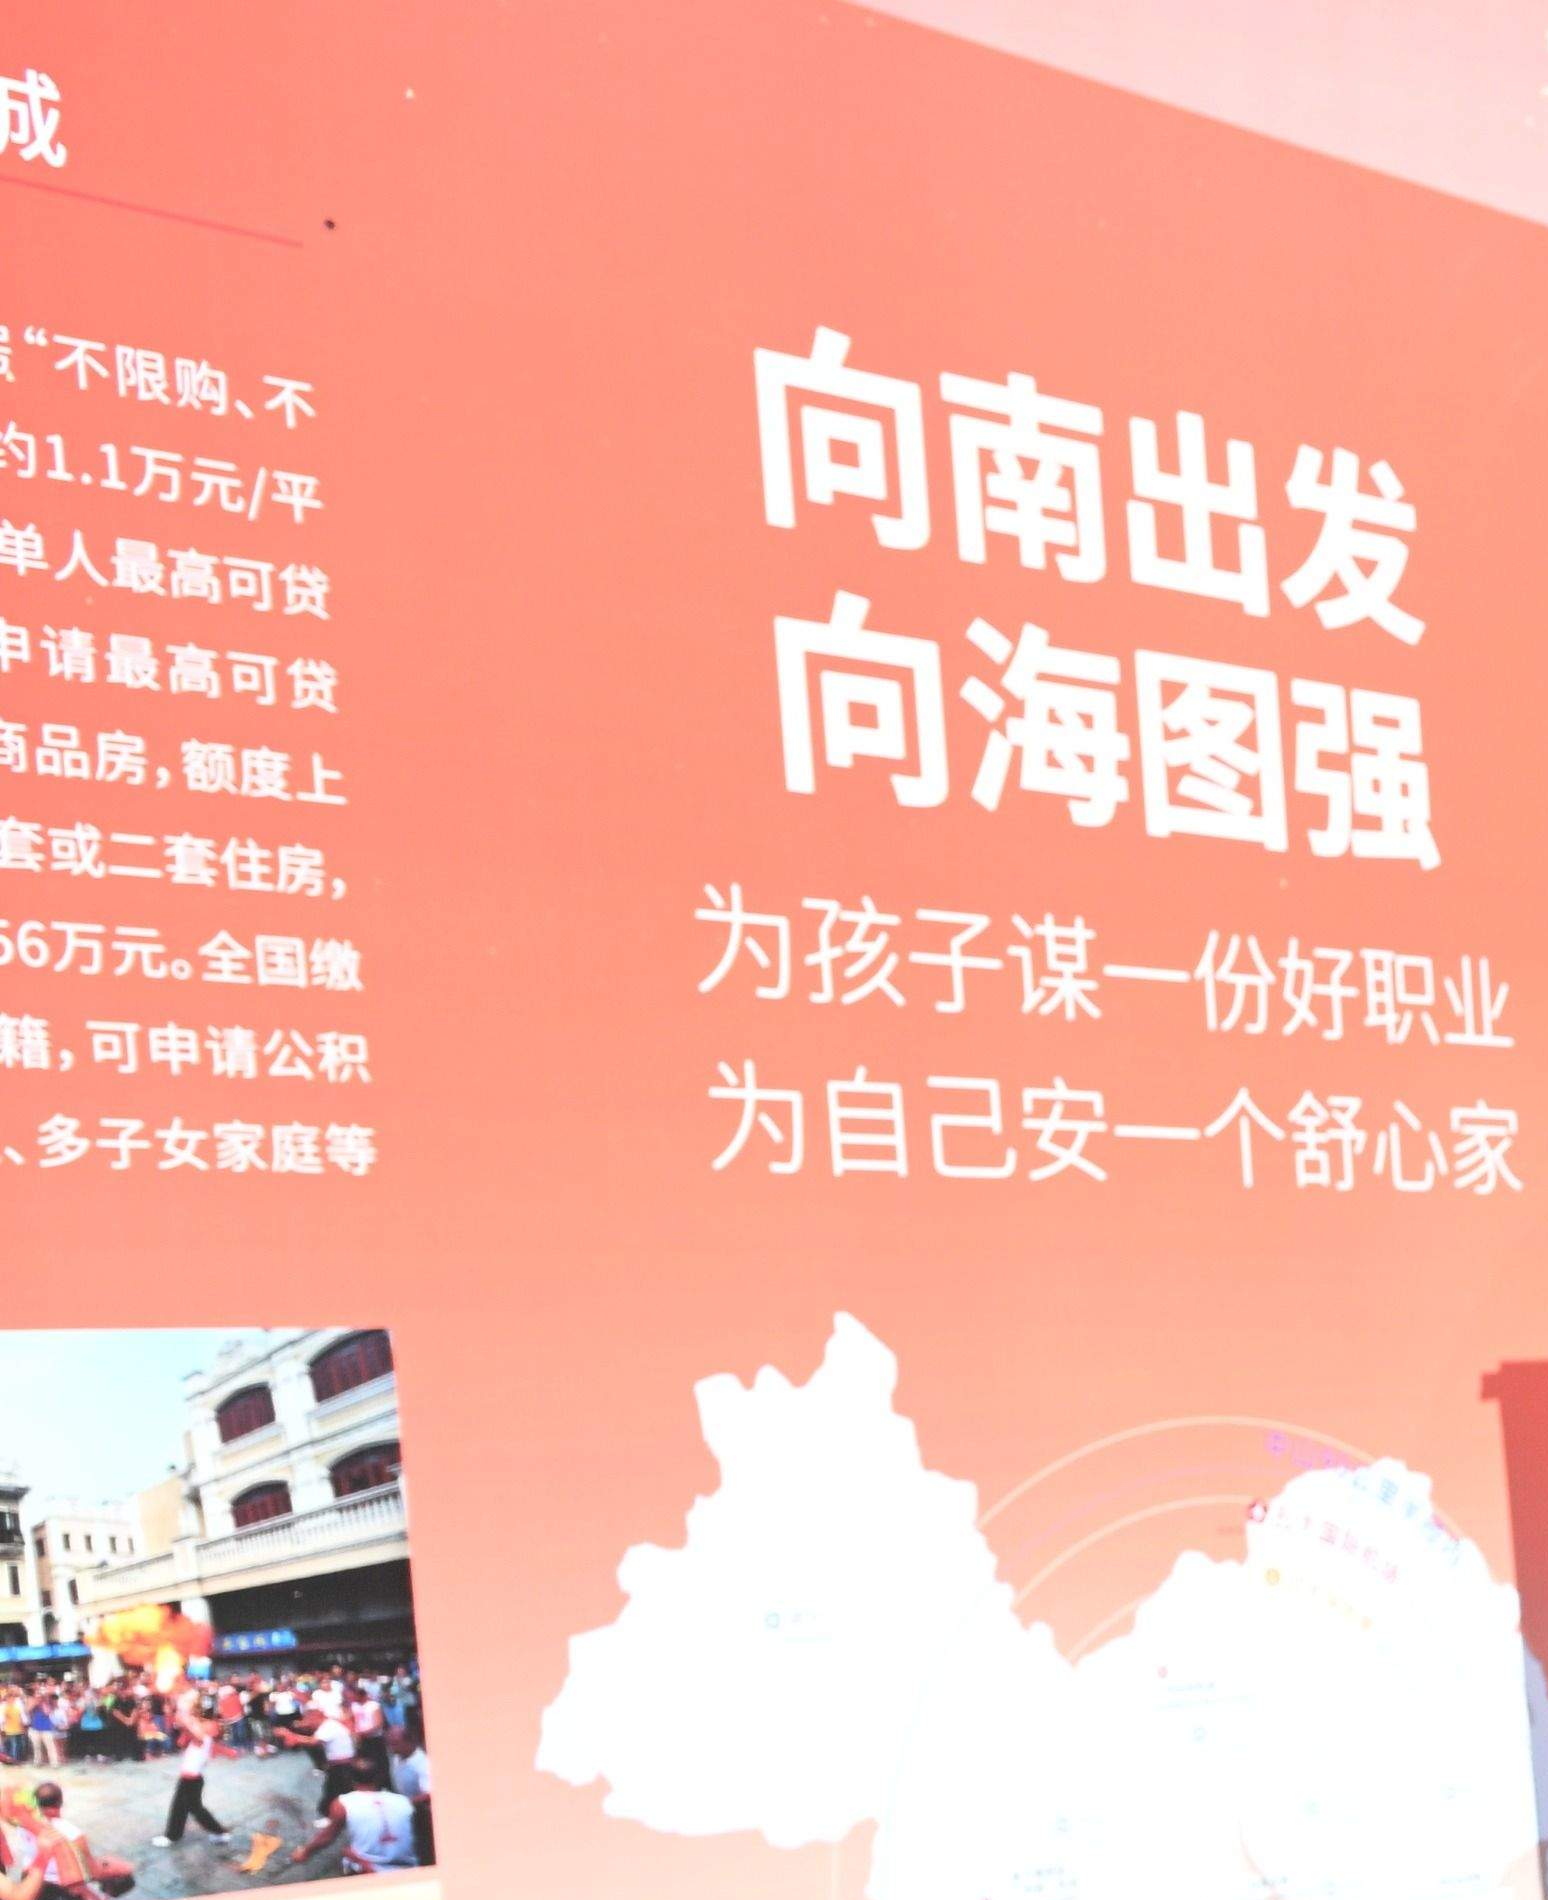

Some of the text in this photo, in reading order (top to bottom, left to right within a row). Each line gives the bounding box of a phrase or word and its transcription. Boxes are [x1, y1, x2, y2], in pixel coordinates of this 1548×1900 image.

[0, 420, 325, 524] 约1.1万元/平
[754, 326, 1426, 645] 向南出发
[0, 518, 331, 620] 单人最高可贷
[0, 616, 339, 713] 申请最高可贷
[773, 589, 1441, 870] 向海图强
[0, 817, 346, 900] 套或二套住房，
[694, 882, 1515, 1048] 为孩子谋一份好职业
[0, 1011, 373, 1084] 籍，可申请公积
[0, 1113, 377, 1177] 、多子女家庭等
[708, 1059, 1524, 1195] 为自己安一个舒心家
